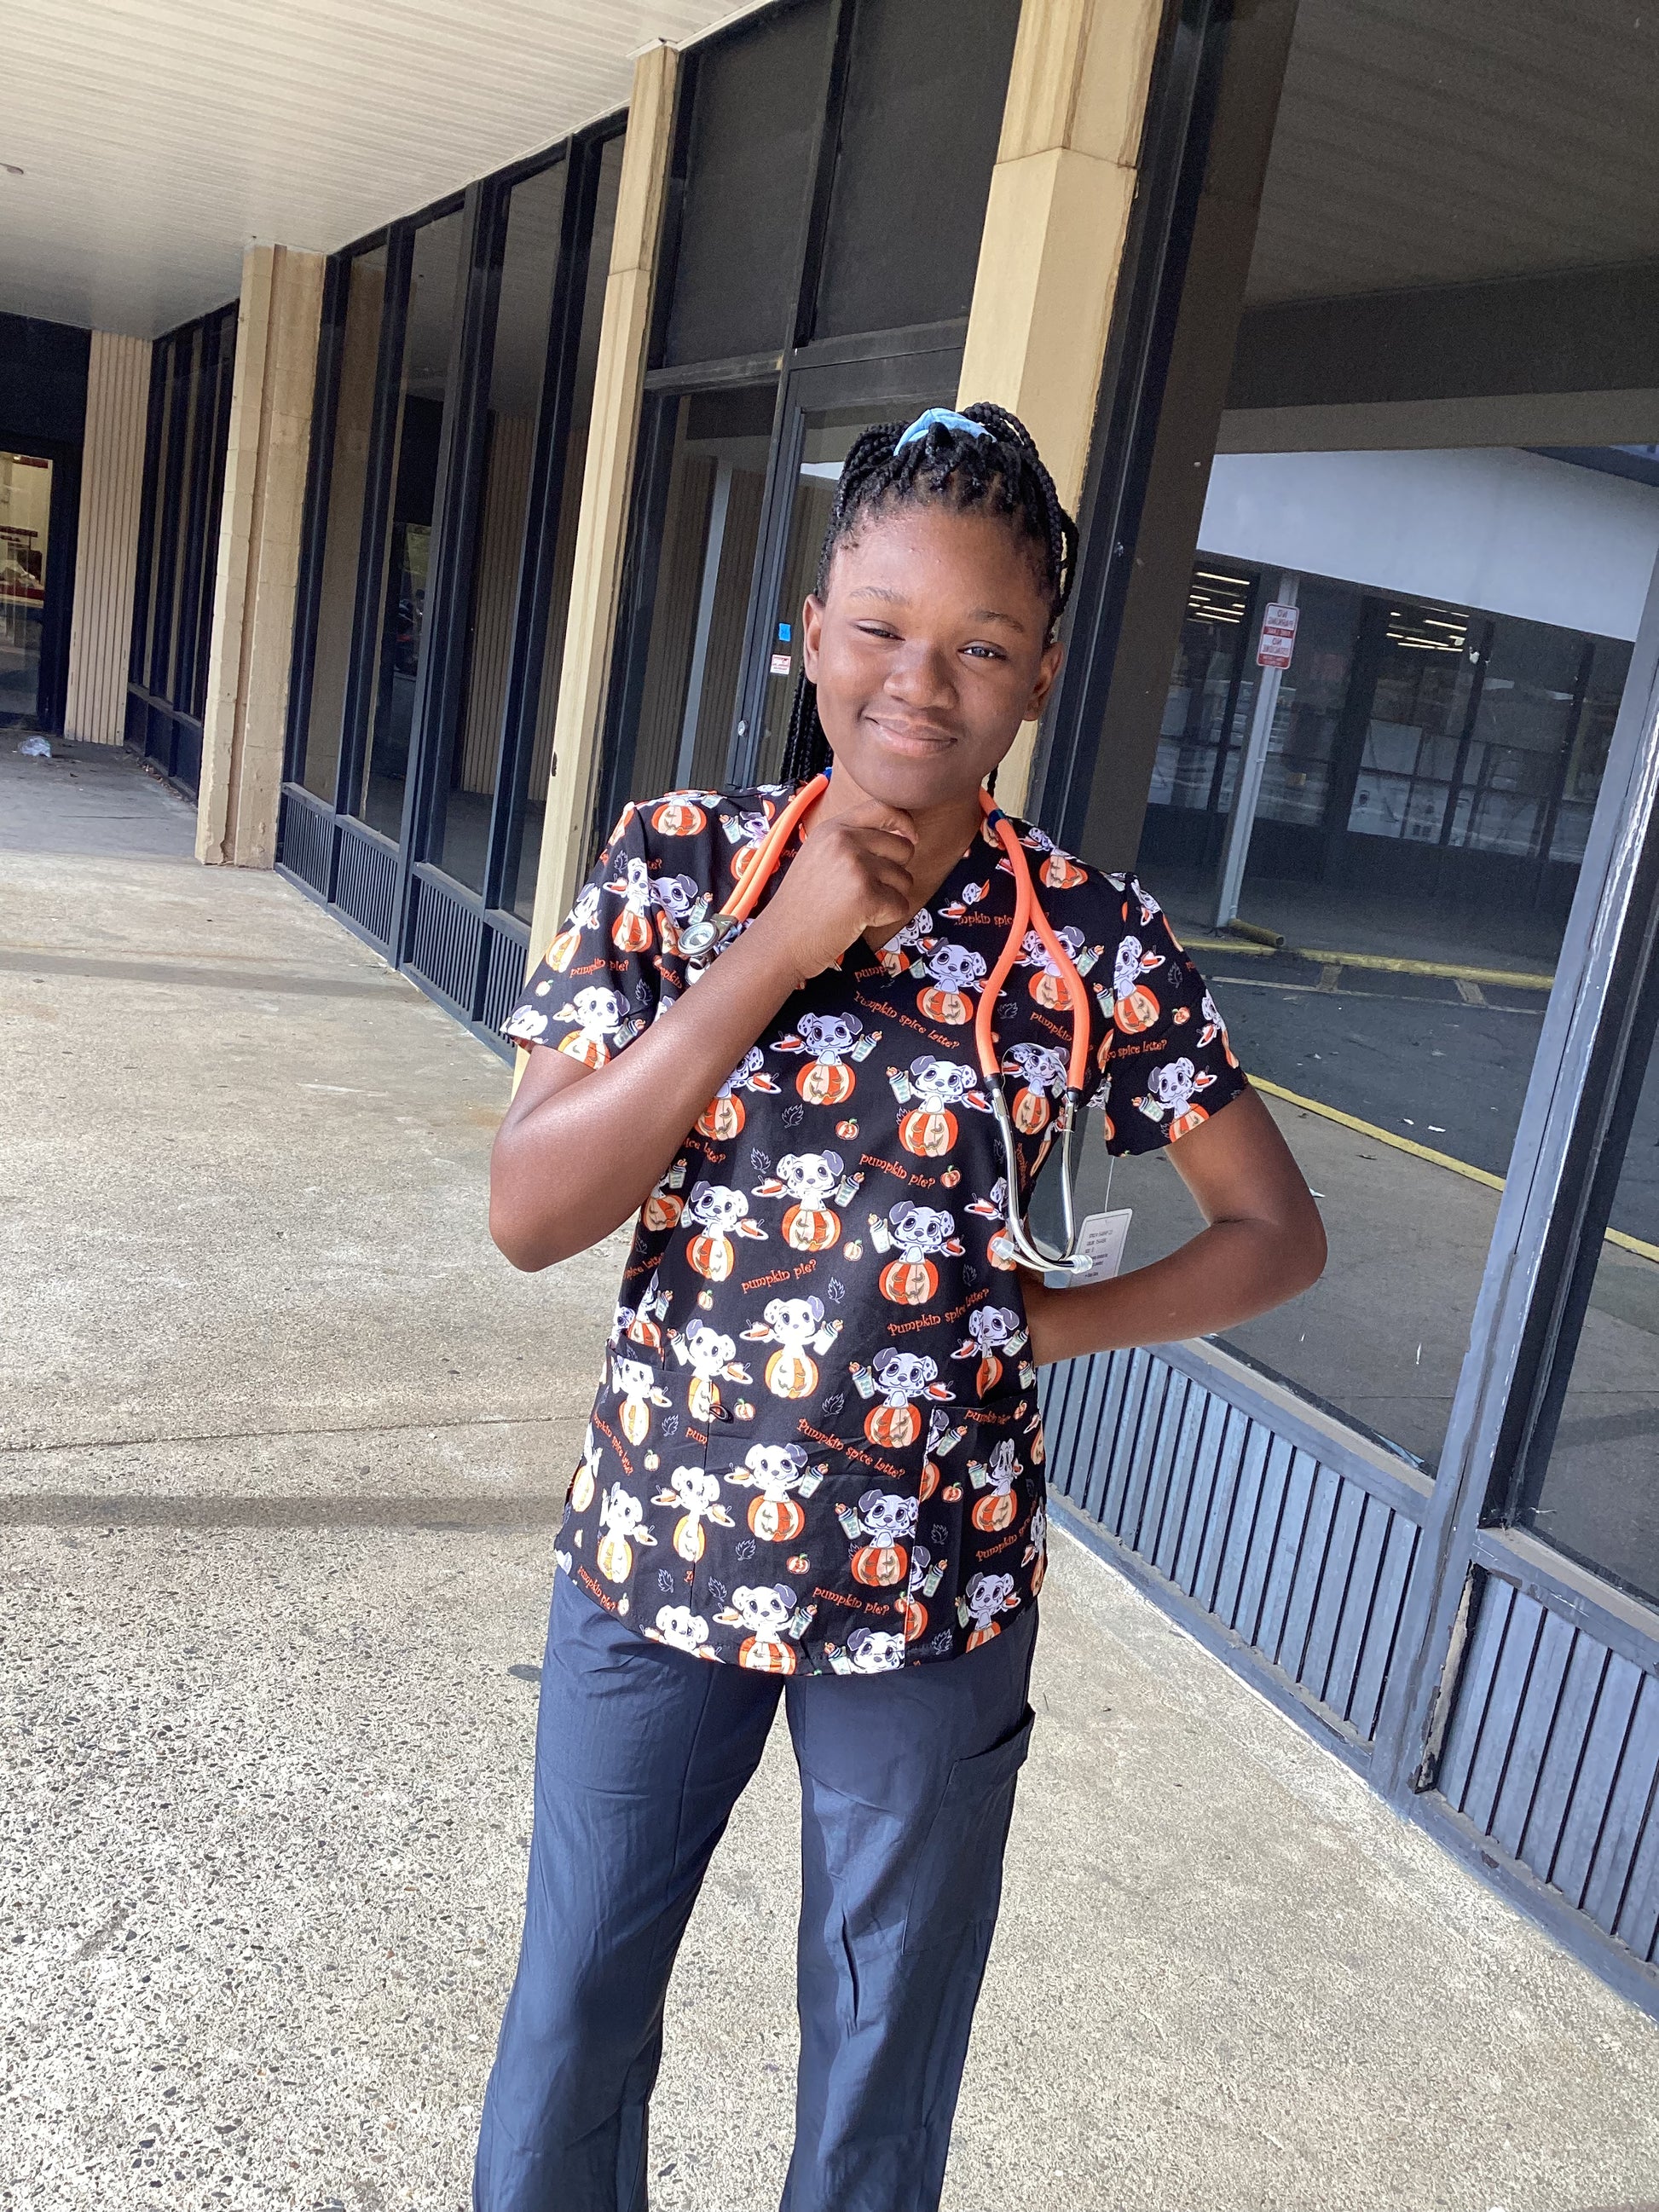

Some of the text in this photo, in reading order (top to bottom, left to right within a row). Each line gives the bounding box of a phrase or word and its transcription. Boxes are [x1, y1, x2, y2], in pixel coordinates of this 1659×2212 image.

[993, 915, 1014, 927] spic
[899, 1014, 927, 1034] spice
[1030, 1011, 1072, 1042] pumpkin
[1118, 1044, 1141, 1059] spice
[858, 1153, 936, 1189] pumpkin pie?
[741, 1258, 817, 1294] pumpkin pie?
[887, 1314, 941, 1337] Pumpkin
[796, 1418, 844, 1451] Pumpkin
[846, 1447, 874, 1466] spice
[974, 1534, 1018, 1562] Pumpkin
[812, 1586, 890, 1616] pumpkin pie?
